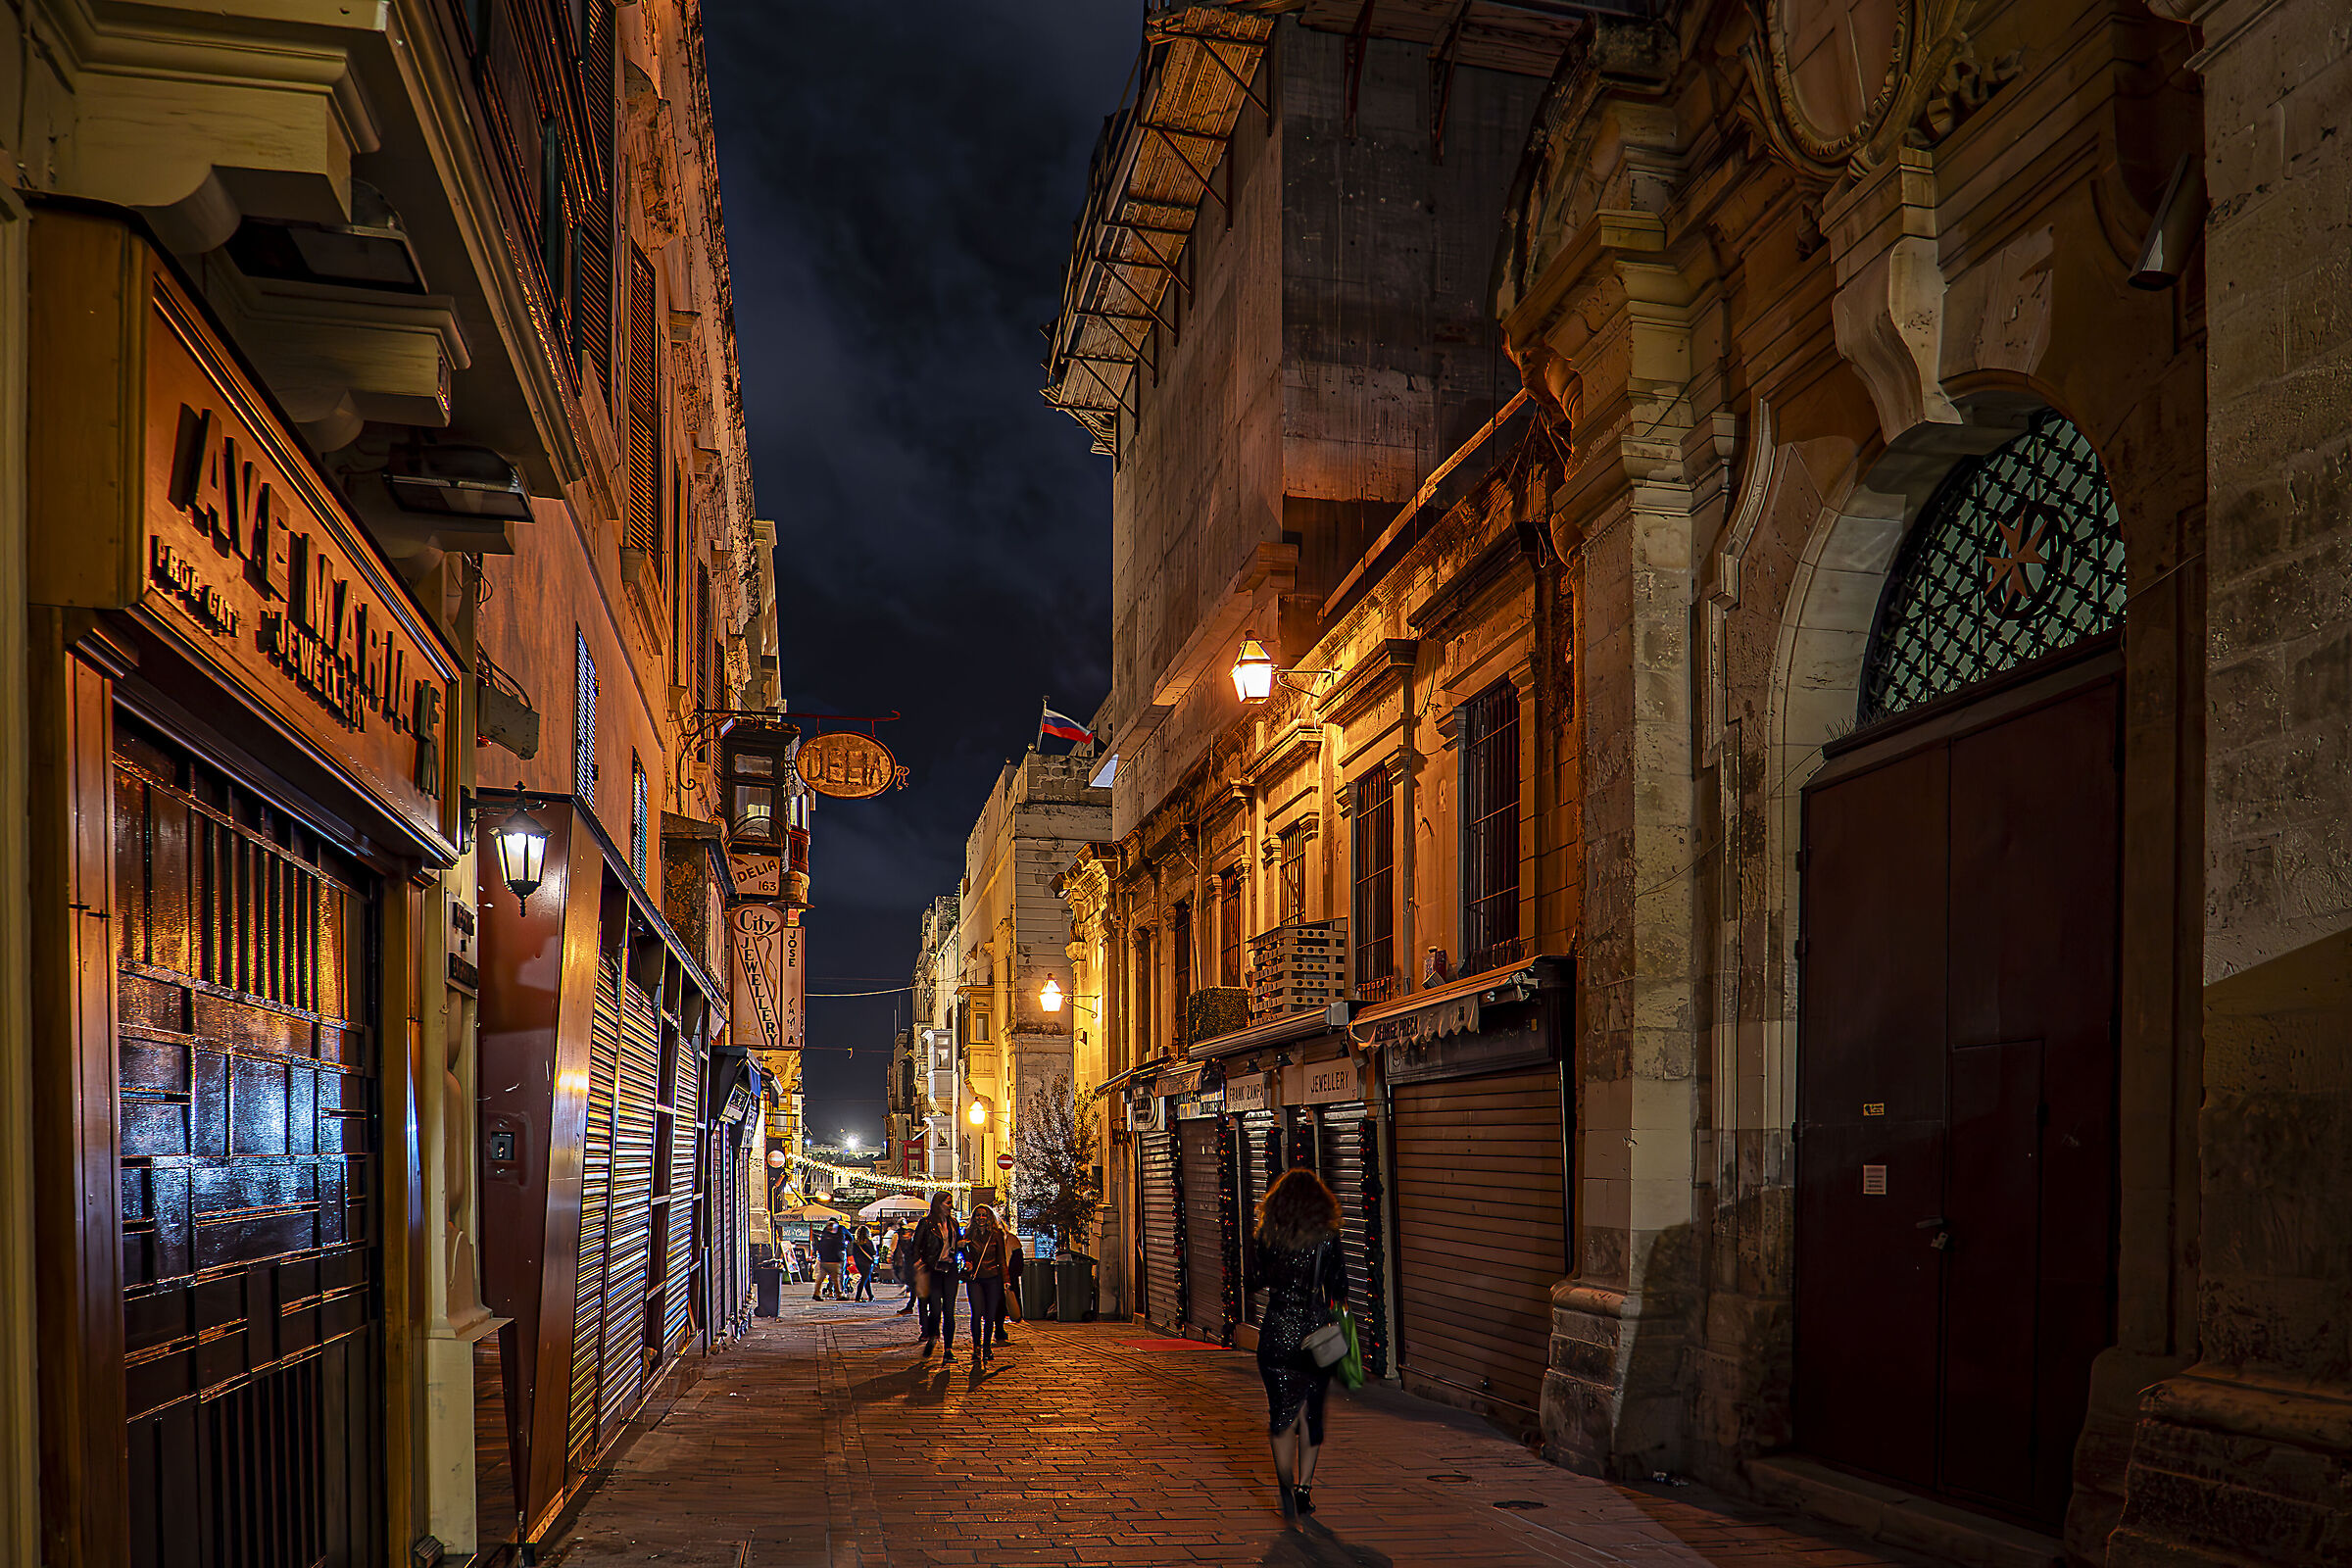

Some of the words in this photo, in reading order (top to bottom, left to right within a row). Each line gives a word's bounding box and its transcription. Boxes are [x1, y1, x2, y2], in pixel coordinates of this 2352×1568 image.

[192, 407, 291, 603] AVE
[298, 532, 416, 735] MARIA
[273, 612, 369, 734] JEWELLERY
[737, 859, 777, 883] DELIA
[759, 880, 777, 892] 163
[740, 909, 776, 936] City
[788, 930, 798, 968] JOSE
[741, 937, 777, 1046] JEWELLERY
[1310, 1071, 1349, 1094] JEWELLERY
